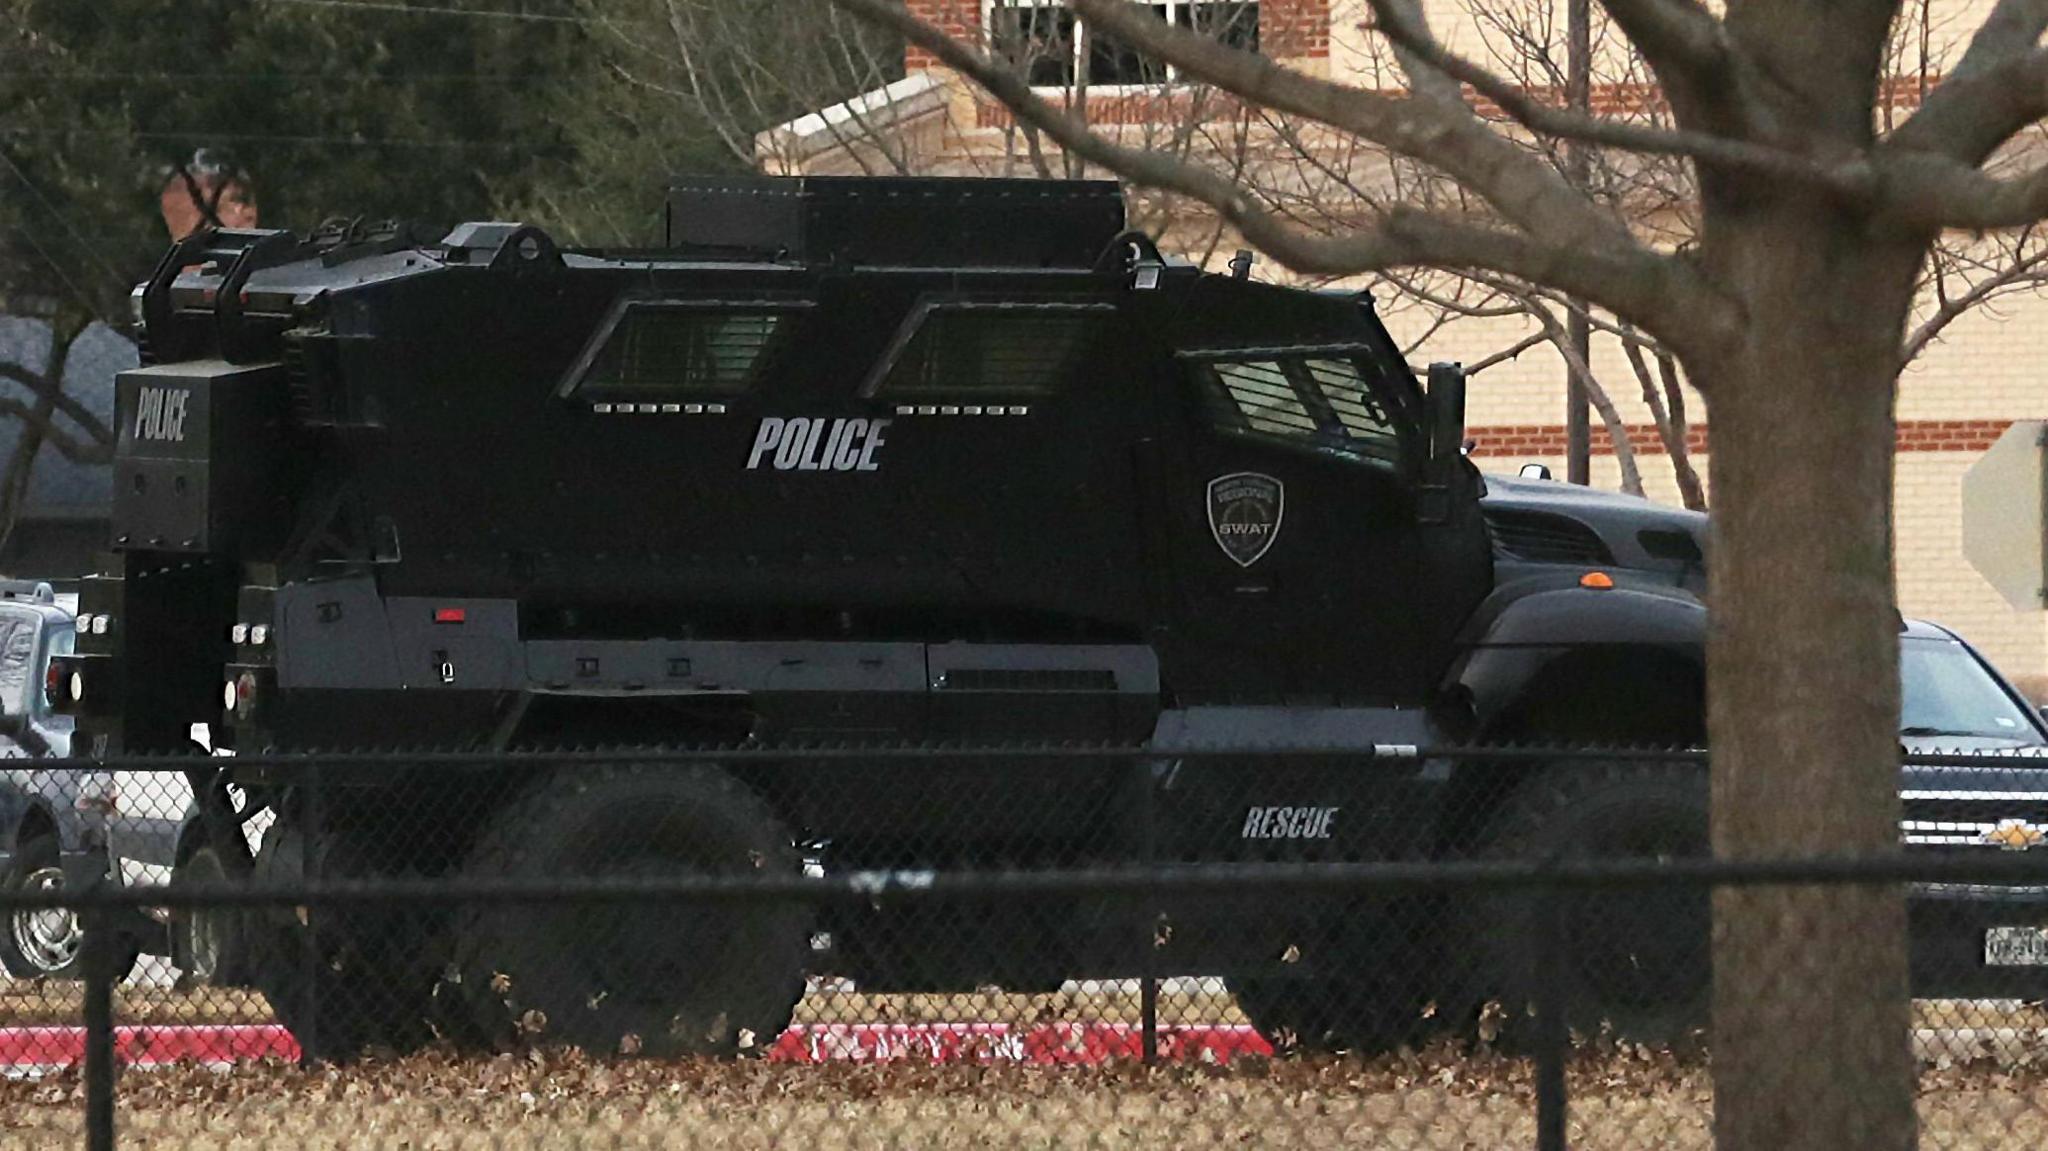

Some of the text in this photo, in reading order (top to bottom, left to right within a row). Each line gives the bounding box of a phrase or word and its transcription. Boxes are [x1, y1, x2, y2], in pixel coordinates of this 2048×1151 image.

[135, 387, 190, 441] POLICE
[746, 417, 893, 471] POLICE
[1219, 523, 1273, 535] SWAT
[1242, 807, 1339, 838] RESCUE
